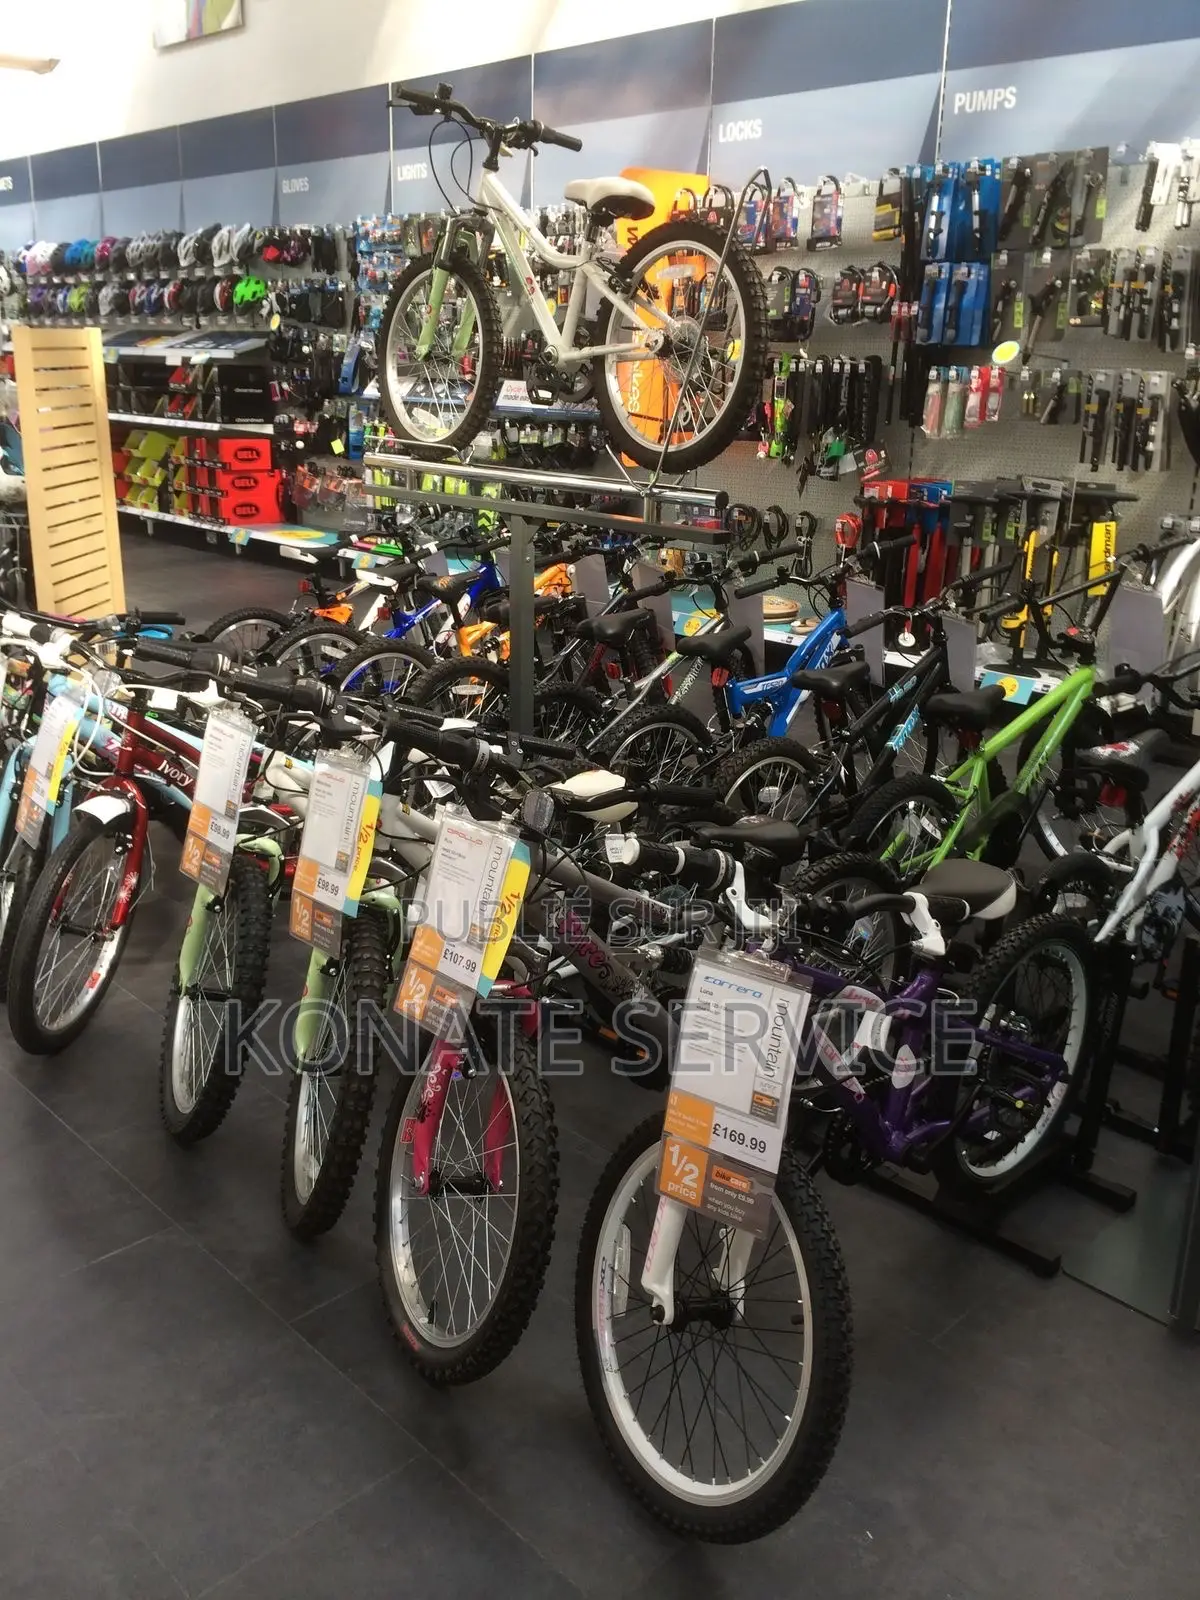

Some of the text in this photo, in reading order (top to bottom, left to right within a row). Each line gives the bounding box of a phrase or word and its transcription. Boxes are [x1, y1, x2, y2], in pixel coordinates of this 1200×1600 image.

[953, 86, 1017, 115] PUMPS
[718, 119, 763, 143] LOCKS
[397, 162, 428, 182] LIGHTS
[281, 176, 310, 194] GLOVES
[236, 451, 258, 459] BELL
[234, 479, 256, 487] BELL
[235, 506, 257, 515] BELL
[157, 759, 194, 787] Ivory
[359, 822, 374, 844] 1/2
[187, 838, 201, 865] 1/2
[317, 878, 339, 896] £98.99
[480, 845, 503, 913] mountain
[295, 896, 310, 925] 1/2
[500, 891, 521, 917] 1/2
[442, 948, 477, 973] £107.99
[408, 968, 427, 997] 1/2
[704, 975, 763, 999] carrera
[764, 998, 789, 1078] mountain
[712, 1123, 767, 1153] £169.99
[669, 1144, 699, 1188] 1/2
[668, 1181, 697, 1200] price
